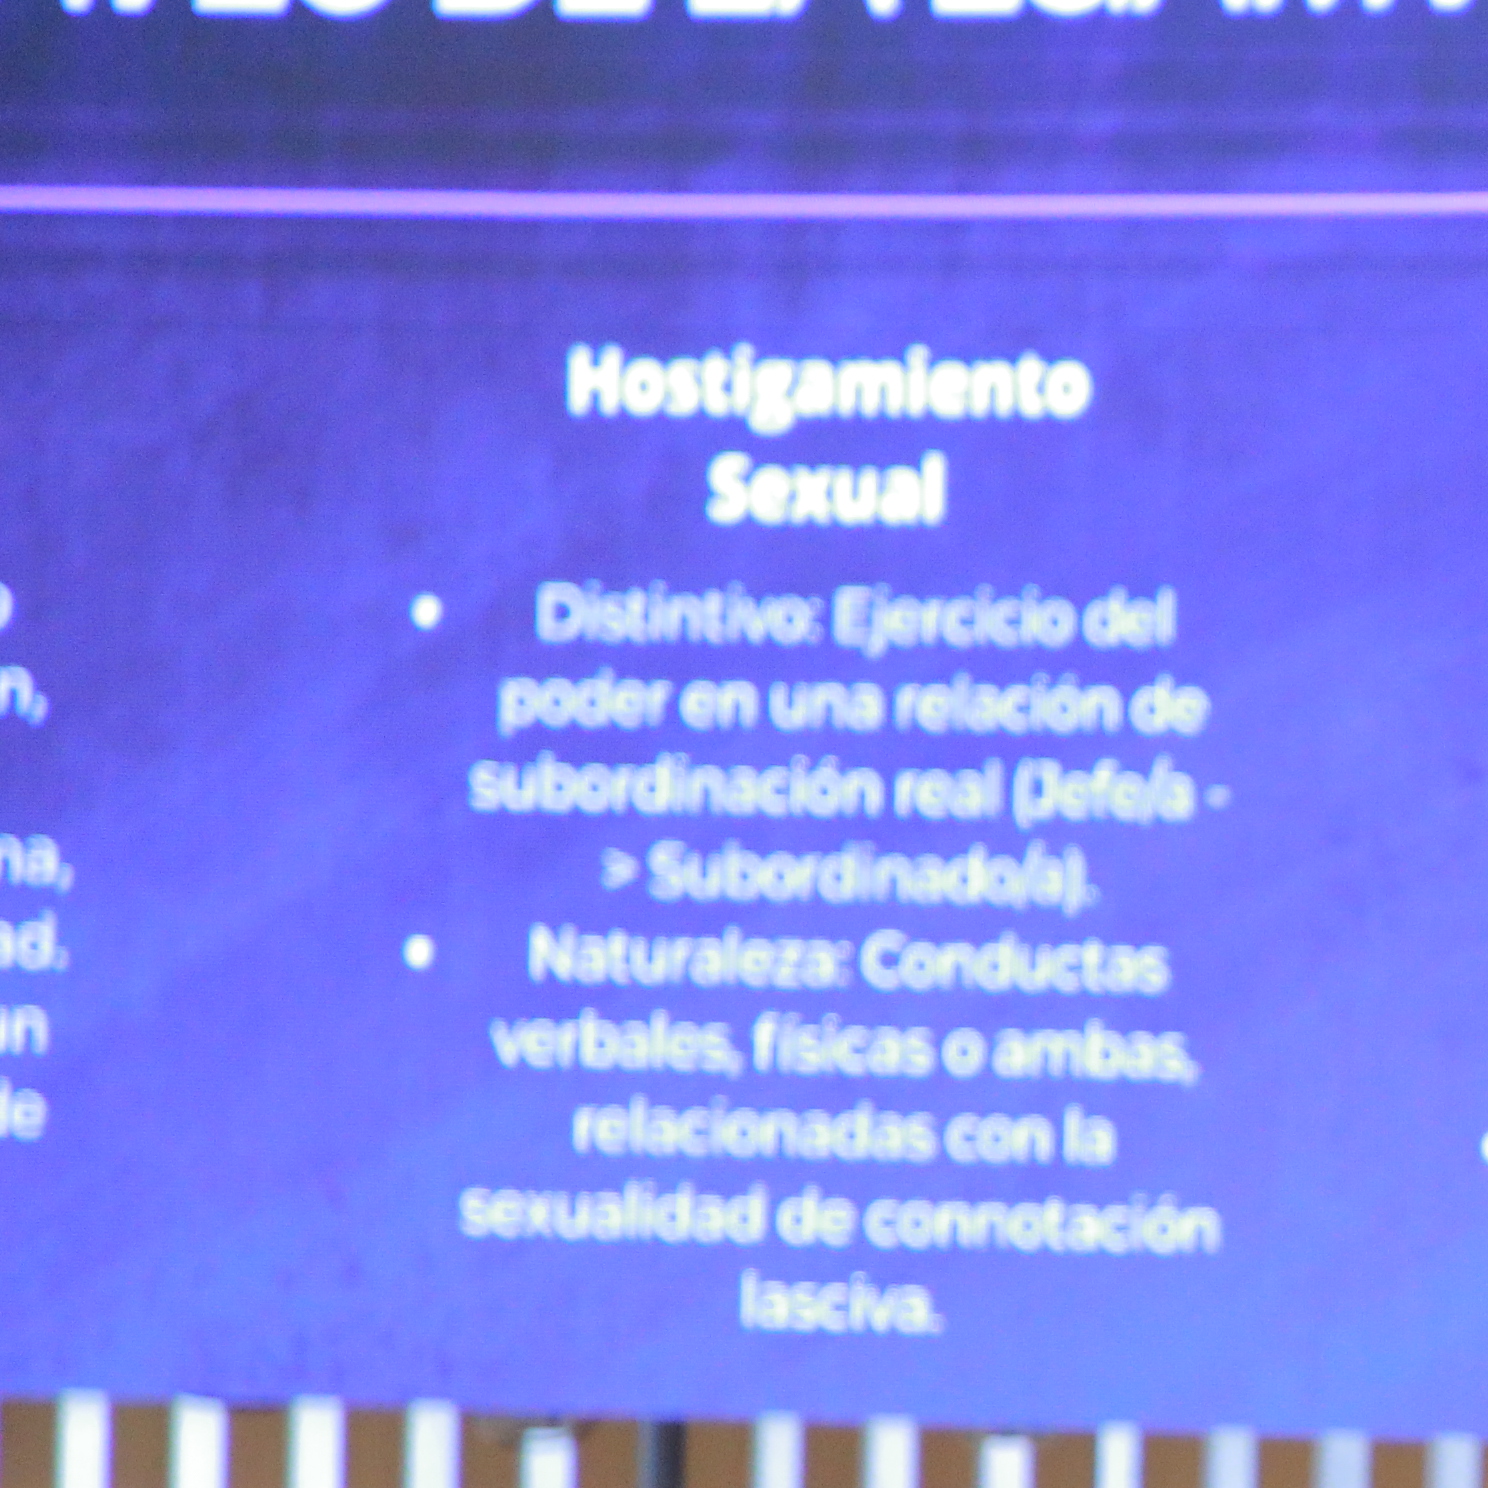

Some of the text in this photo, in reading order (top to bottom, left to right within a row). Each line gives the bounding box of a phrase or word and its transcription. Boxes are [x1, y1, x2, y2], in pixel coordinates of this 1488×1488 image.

[568, 343, 1093, 436] Hostigamiento
[707, 450, 947, 526] Sexual
[538, 582, 1176, 657] Distintivo: Ejercicio del
[500, 670, 1211, 735] poder en una relación de
[471, 752, 884, 817] subordinación
[894, 760, 1004, 819] real
[529, 922, 1171, 994] Naturaleza: Conductas
[491, 1007, 744, 1078] verbales,
[941, 1026, 989, 1078] o
[992, 1017, 1203, 1085] ambas,
[572, 1094, 1118, 1166] relacionadas con la
[460, 1179, 1223, 1256] sexualidad de connotación
[739, 1267, 945, 1335] lasciva.
